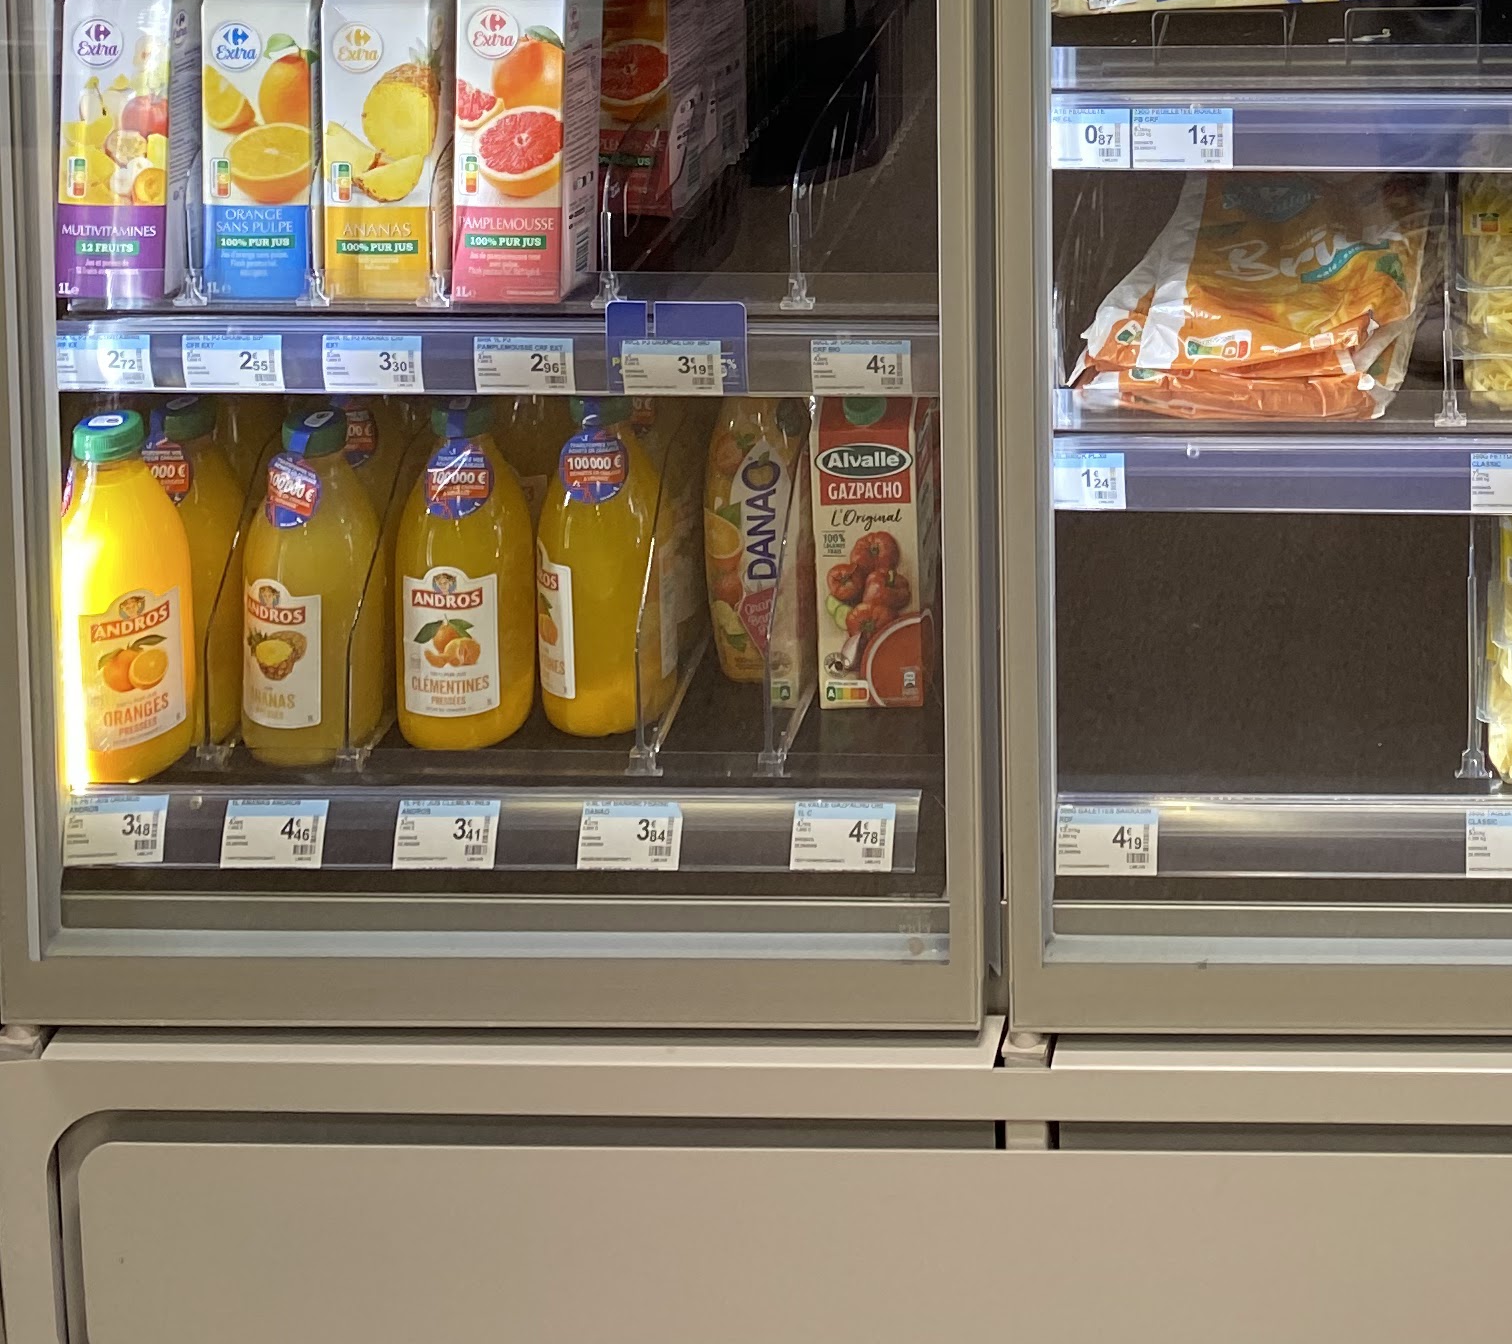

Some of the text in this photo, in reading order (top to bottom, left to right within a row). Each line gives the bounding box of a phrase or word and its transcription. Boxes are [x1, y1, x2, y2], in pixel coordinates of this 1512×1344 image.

[472, 31, 515, 48] Extra
[77, 41, 119, 57] Extra
[214, 44, 257, 61] Extra
[336, 46, 379, 62] Extra
[225, 209, 282, 221] ORANGE
[61, 224, 157, 238] MULTIVITAMINES
[216, 221, 293, 234] SANS PULPE
[343, 222, 411, 237] ANANAS
[459, 216, 554, 231] PAMPLEMOUSSE
[81, 243, 134, 253] 12 FRUITS
[220, 238, 289, 248] 100% PUR JUS
[341, 242, 414, 252] 100% PUR JUS
[470, 237, 541, 247] 100% PUR JUS
[610, 455, 621, 469] €
[826, 451, 900, 470] Alvalle
[828, 481, 902, 501] GAZPACHO
[742, 458, 781, 581] DANAO
[830, 508, 902, 531] L'Original
[823, 533, 846, 543] 100%
[413, 588, 482, 609] ANDROS
[93, 602, 170, 640] ANDROS
[411, 674, 489, 694] CLÉMENTINES
[104, 692, 169, 728] ORANGES
